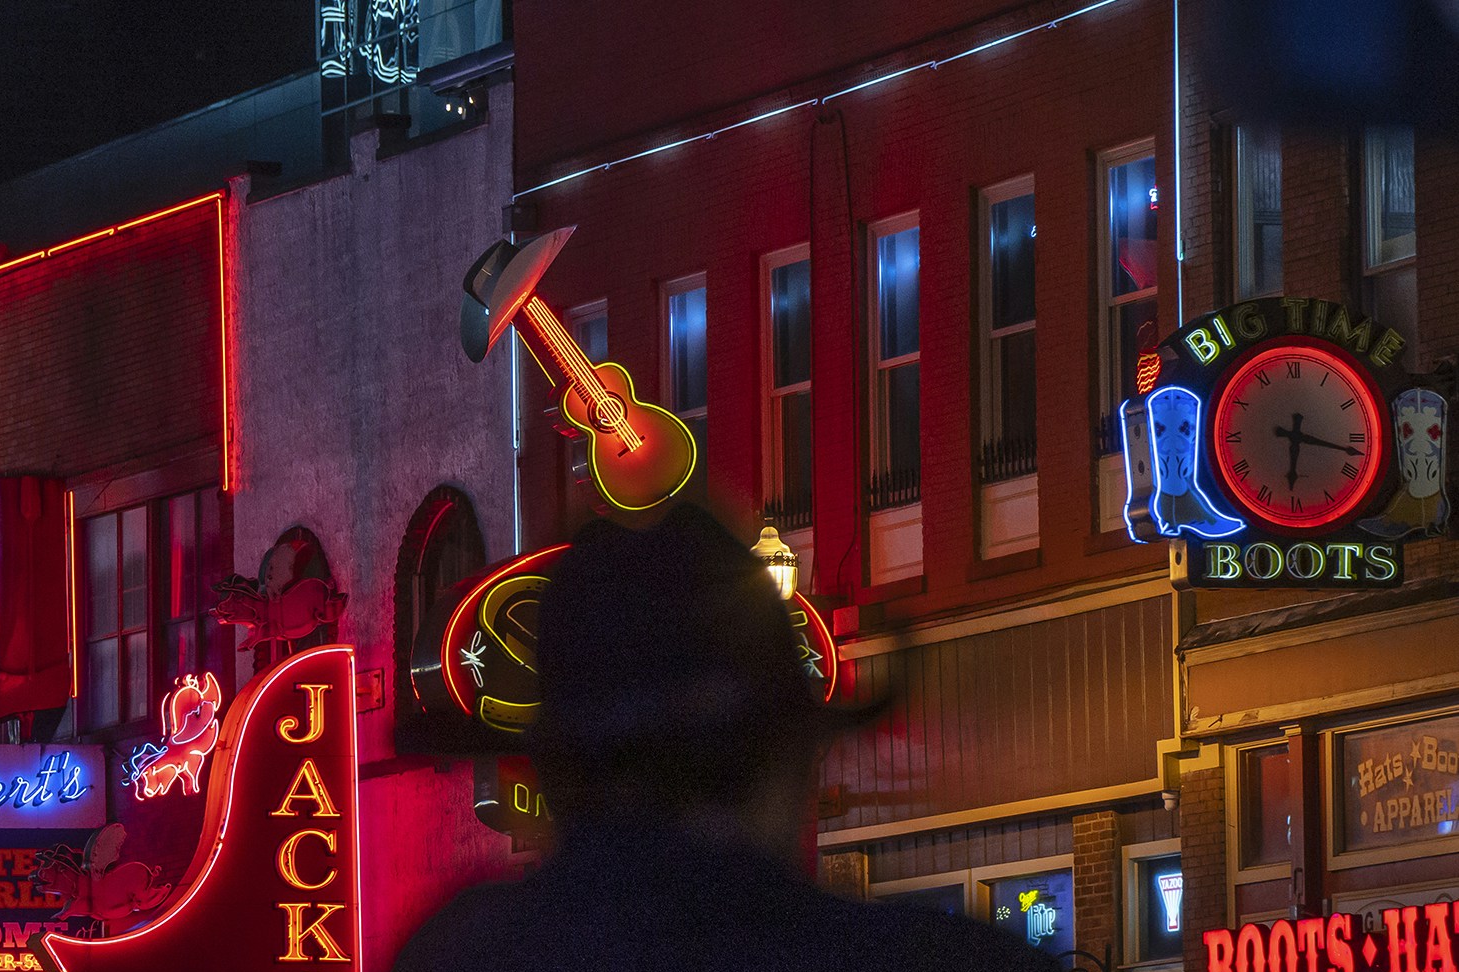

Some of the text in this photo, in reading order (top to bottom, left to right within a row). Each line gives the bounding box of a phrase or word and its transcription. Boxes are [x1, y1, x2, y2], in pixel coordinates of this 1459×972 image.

[1183, 297, 1407, 368] BIG TIME
[1202, 541, 1399, 581] BOOTS
[1357, 751, 1404, 798] Hats
[1372, 788, 1459, 833] APPAREL
[1027, 903, 1056, 946] Lite
